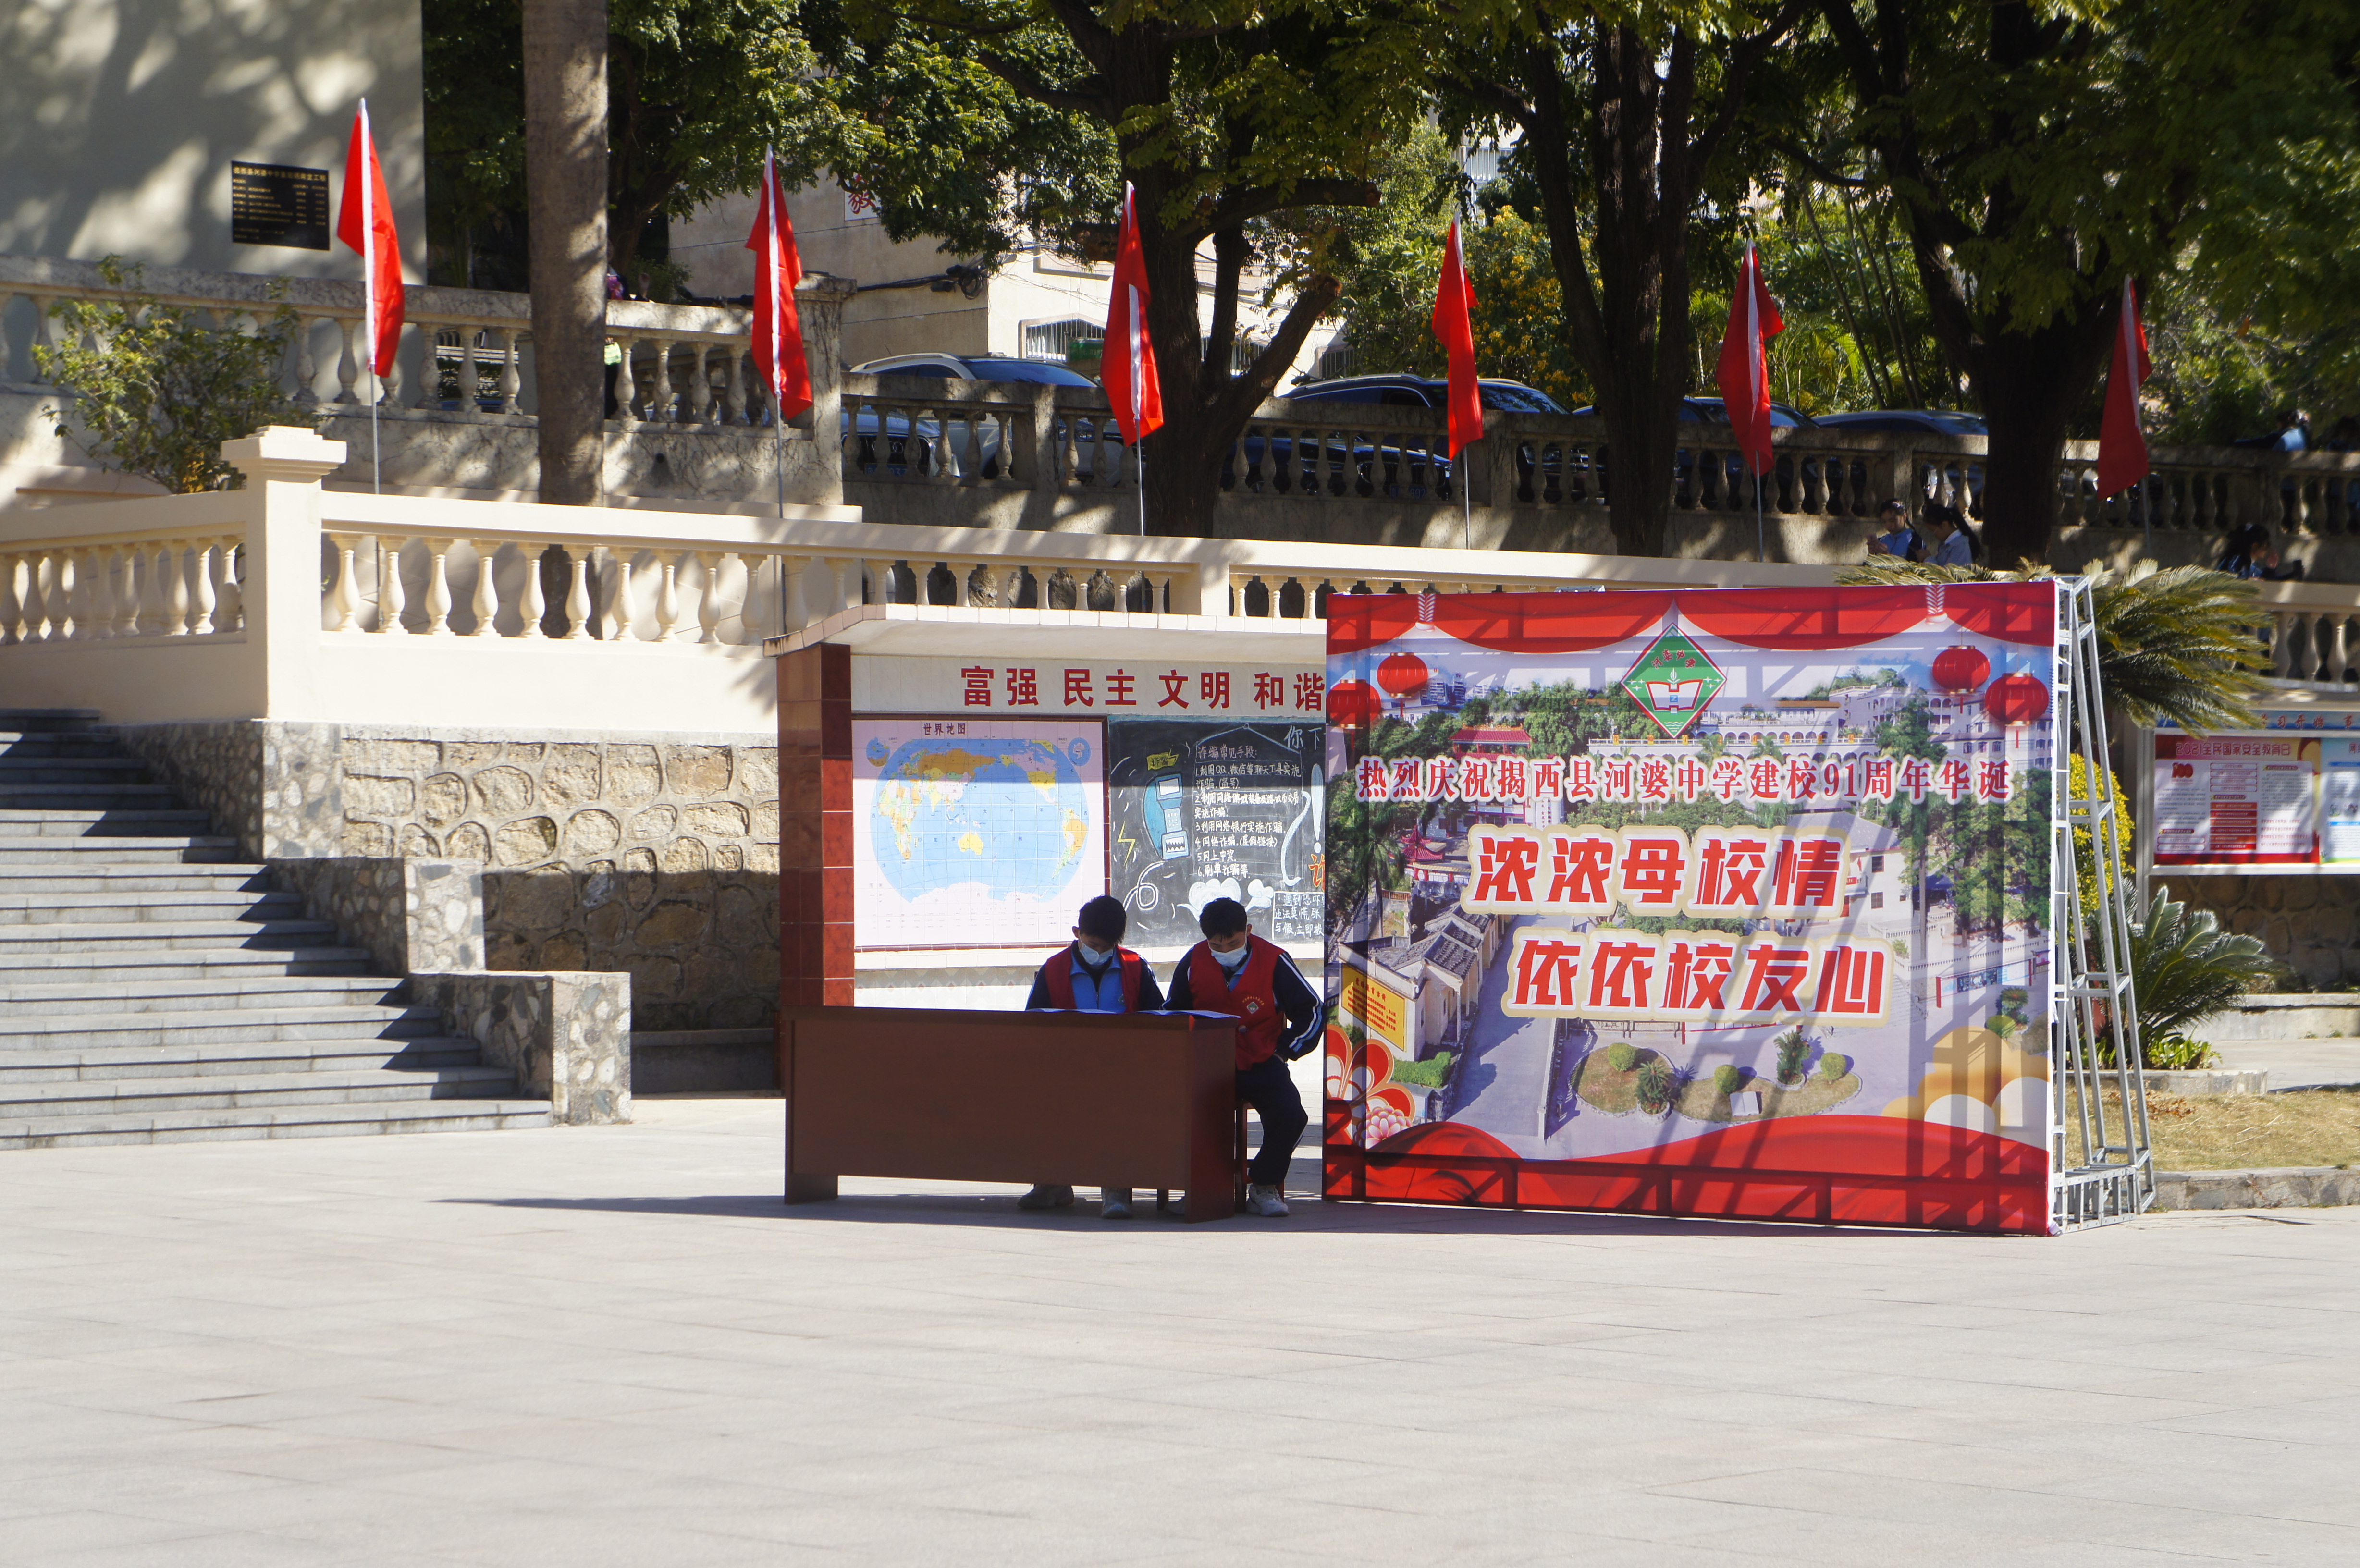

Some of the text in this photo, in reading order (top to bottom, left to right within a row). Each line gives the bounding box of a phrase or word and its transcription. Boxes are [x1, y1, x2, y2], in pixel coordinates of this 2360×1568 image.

[961, 665, 1325, 711] 富强 民主 文明 和谐
[923, 723, 966, 735] 世界地图
[2176, 742, 2291, 756] 2021全民国家安全教育日
[1358, 759, 2010, 800] 热烈庆祝揭西县河婆中学建校91周年华诞
[1473, 836, 1841, 906] 浓浓母校情
[1511, 939, 1885, 1015] 依依校友心
